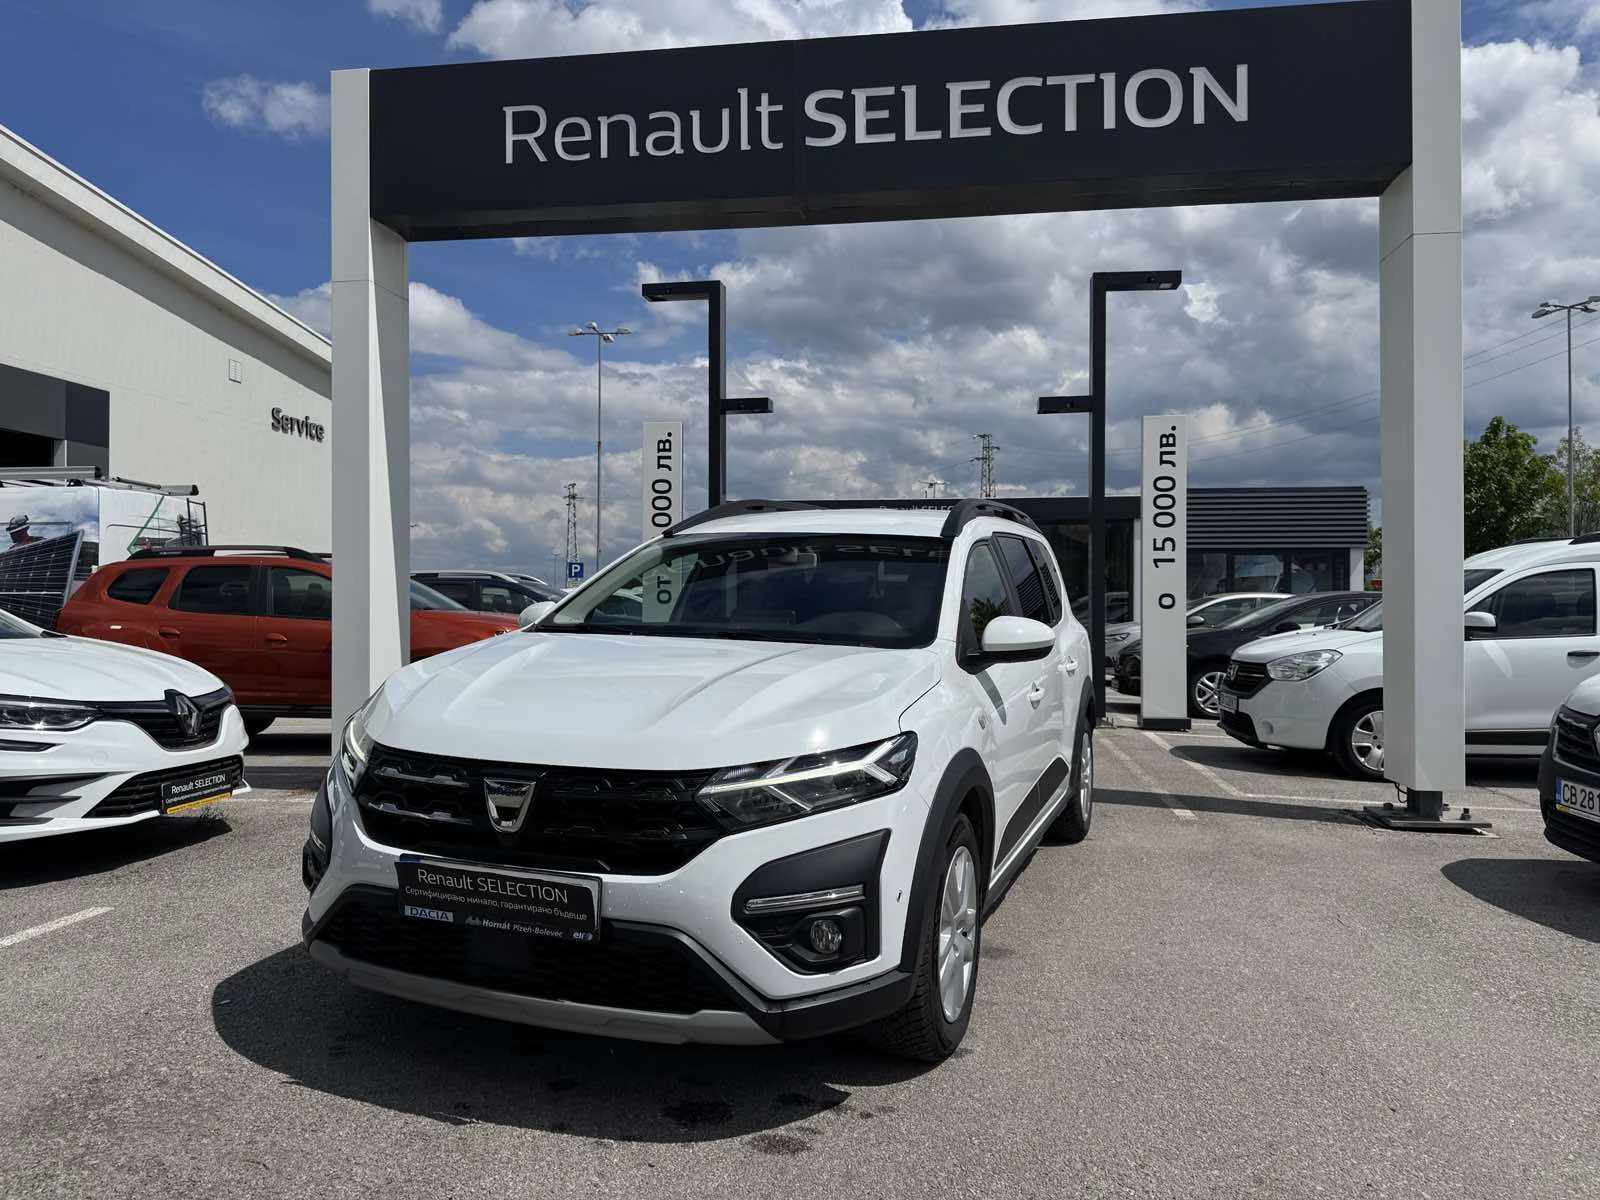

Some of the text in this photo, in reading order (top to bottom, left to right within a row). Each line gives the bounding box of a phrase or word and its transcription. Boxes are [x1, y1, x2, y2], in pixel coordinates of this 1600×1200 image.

[502, 63, 1250, 165] Renault SELECTION
[271, 407, 325, 443] Service
[656, 431, 673, 472] лв.
[1159, 425, 1177, 468] лв.
[651, 478, 672, 528] 000
[1153, 475, 1177, 529] 000
[571, 564, 581, 577] P
[1153, 536, 1176, 569] 15
[171, 782, 194, 795] Renault
[194, 774, 226, 788] SELECTION
[417, 868, 568, 904] Renault SELECTION
[410, 907, 450, 921] DACIA
